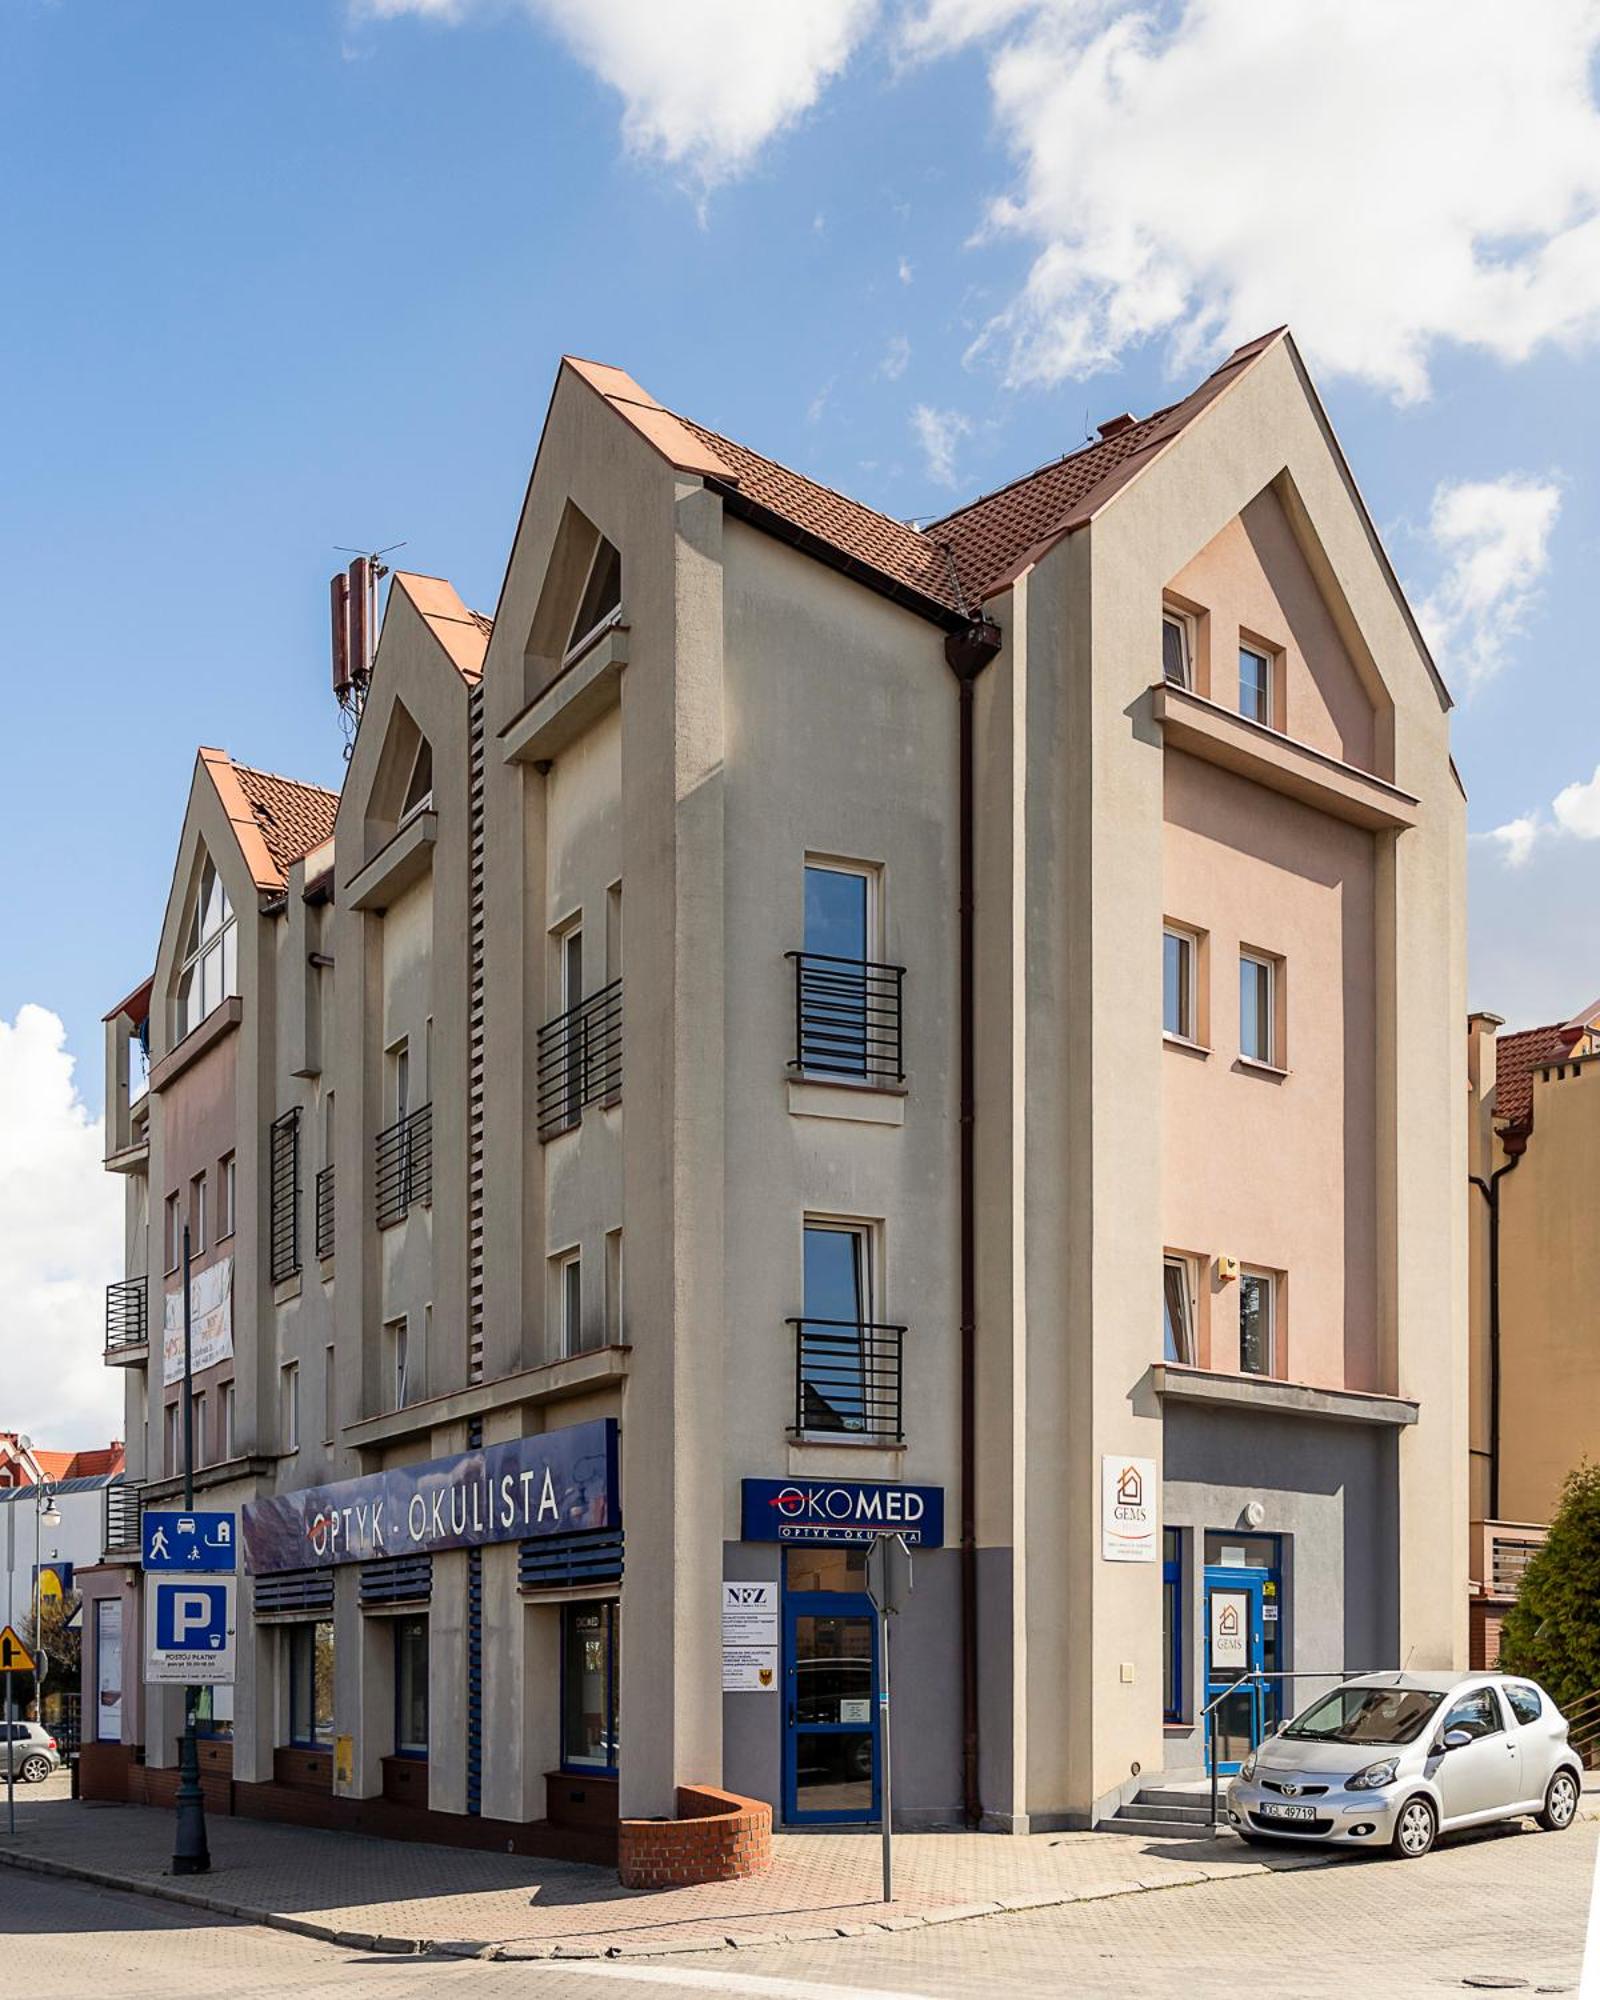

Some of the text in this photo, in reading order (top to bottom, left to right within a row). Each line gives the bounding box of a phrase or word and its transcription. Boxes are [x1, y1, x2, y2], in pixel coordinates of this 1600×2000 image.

[312, 1466, 559, 1556] OPTYK OKULISTA
[777, 1487, 925, 1521] OKOMED
[1113, 1506, 1147, 1522] GEMS
[782, 1528, 918, 1542] OPTYK OKUTA
[173, 1592, 212, 1643] P
[1216, 1637, 1243, 1650] GEMS
[1284, 1806, 1314, 1820] 49719
